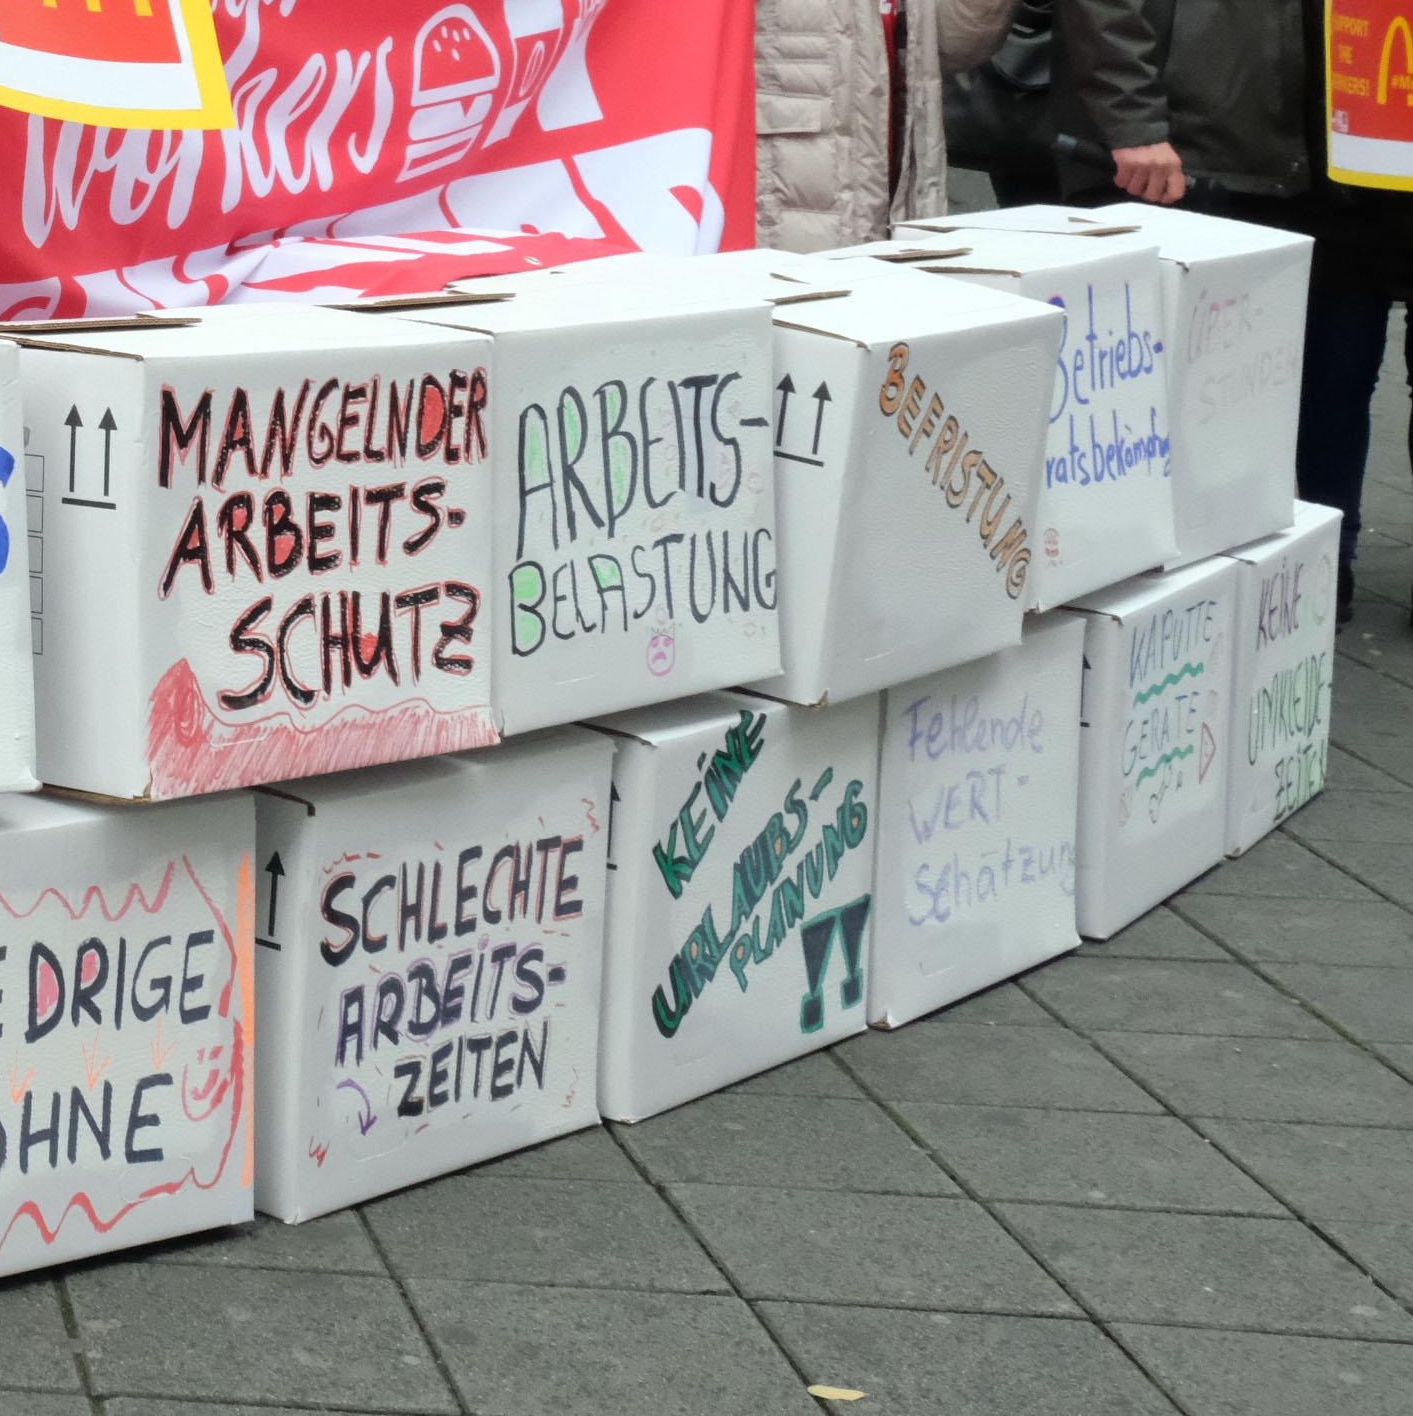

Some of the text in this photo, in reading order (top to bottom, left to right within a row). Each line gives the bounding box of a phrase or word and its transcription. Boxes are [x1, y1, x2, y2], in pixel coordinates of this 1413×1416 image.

[157, 367, 490, 491] MANGELNDER
[516, 372, 769, 561] ARBEITS-
[878, 341, 1033, 600] BEFRISTUNG
[158, 477, 467, 600] ARBEITS-
[509, 528, 778, 657] BELASTUNG
[1256, 555, 1305, 651] KEINE
[218, 580, 482, 711] SCHUTZ
[1130, 600, 1218, 689] KAPUTTE
[905, 695, 1045, 762] Fehlende
[652, 710, 767, 899] KEINE
[320, 835, 585, 967] SCHLECHTE
[652, 767, 834, 1039] URLAUBS-
[730, 780, 868, 993] PLANUNG
[336, 936, 568, 1066] ARBEITS-
[394, 1020, 549, 1118] ZEITEN
